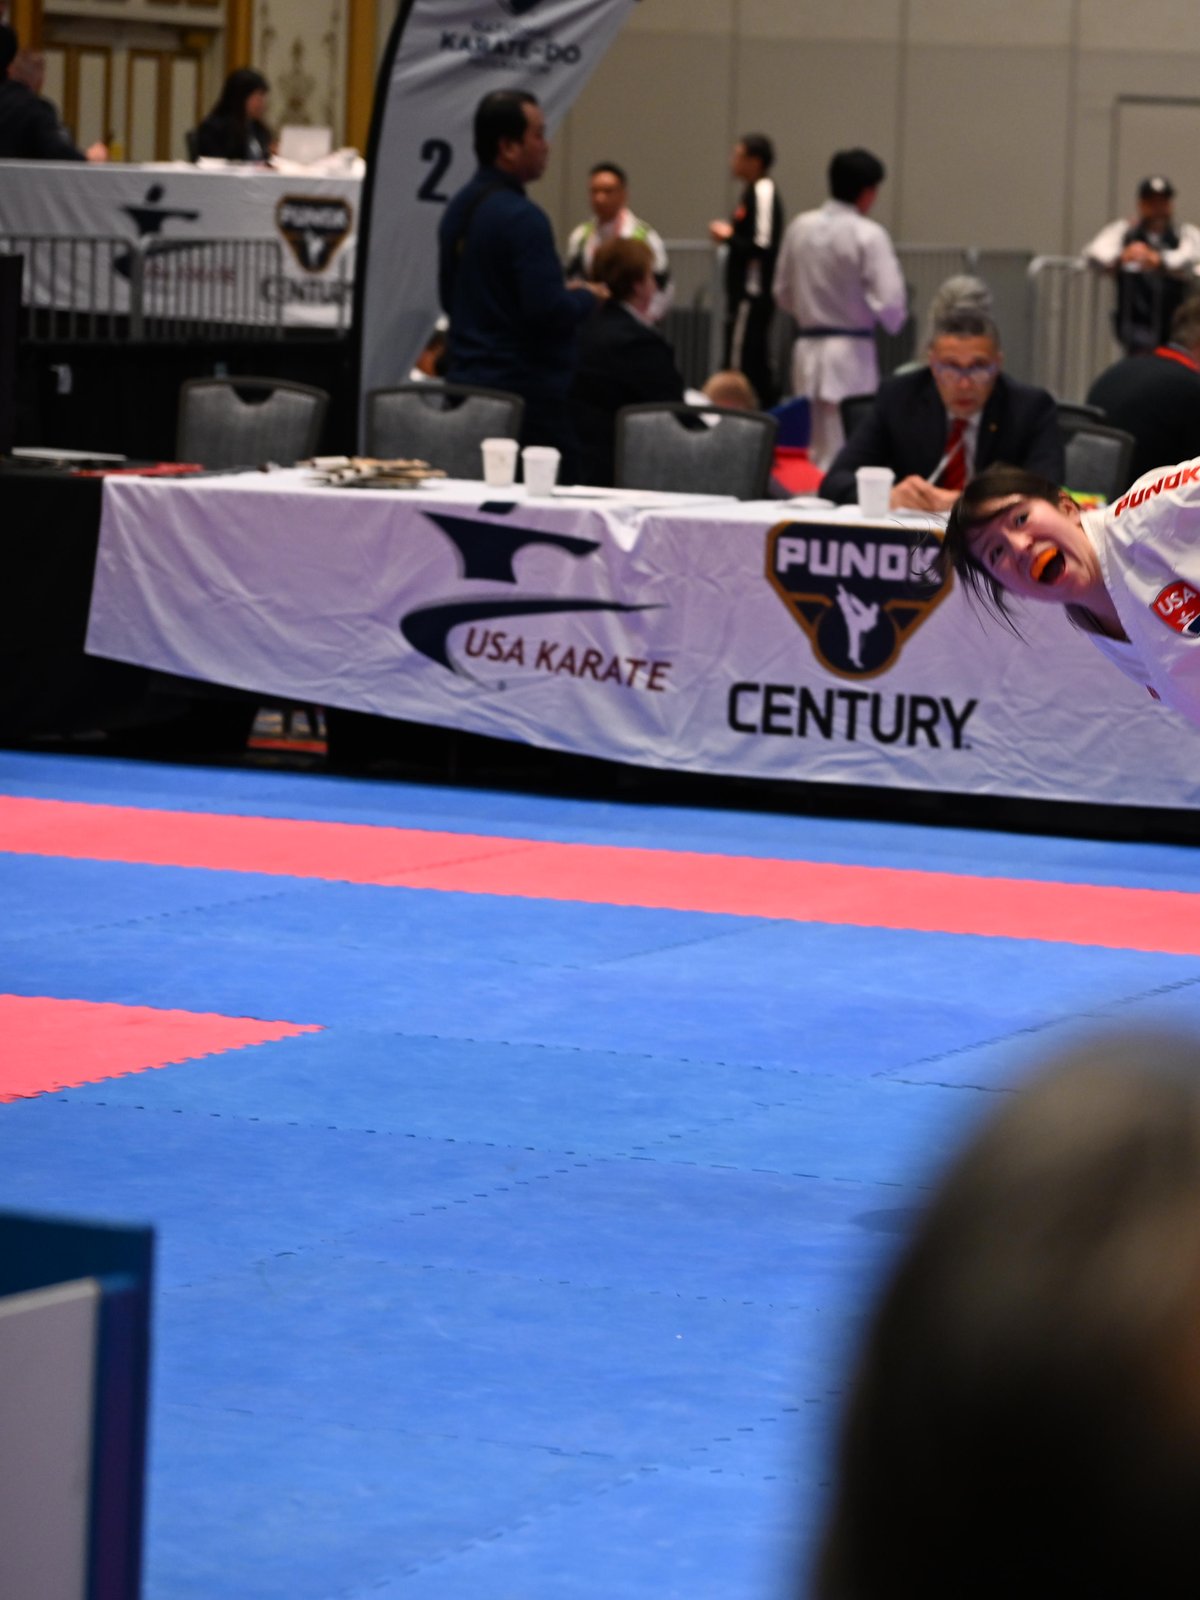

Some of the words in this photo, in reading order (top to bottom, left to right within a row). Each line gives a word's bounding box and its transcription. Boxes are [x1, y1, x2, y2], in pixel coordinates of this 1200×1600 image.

[417, 138, 452, 203] 2
[776, 536, 944, 584] PUNOK
[1157, 586, 1198, 616] USA
[464, 626, 526, 667] USA
[535, 640, 673, 692] KARATE
[728, 681, 979, 750] CENTURY
